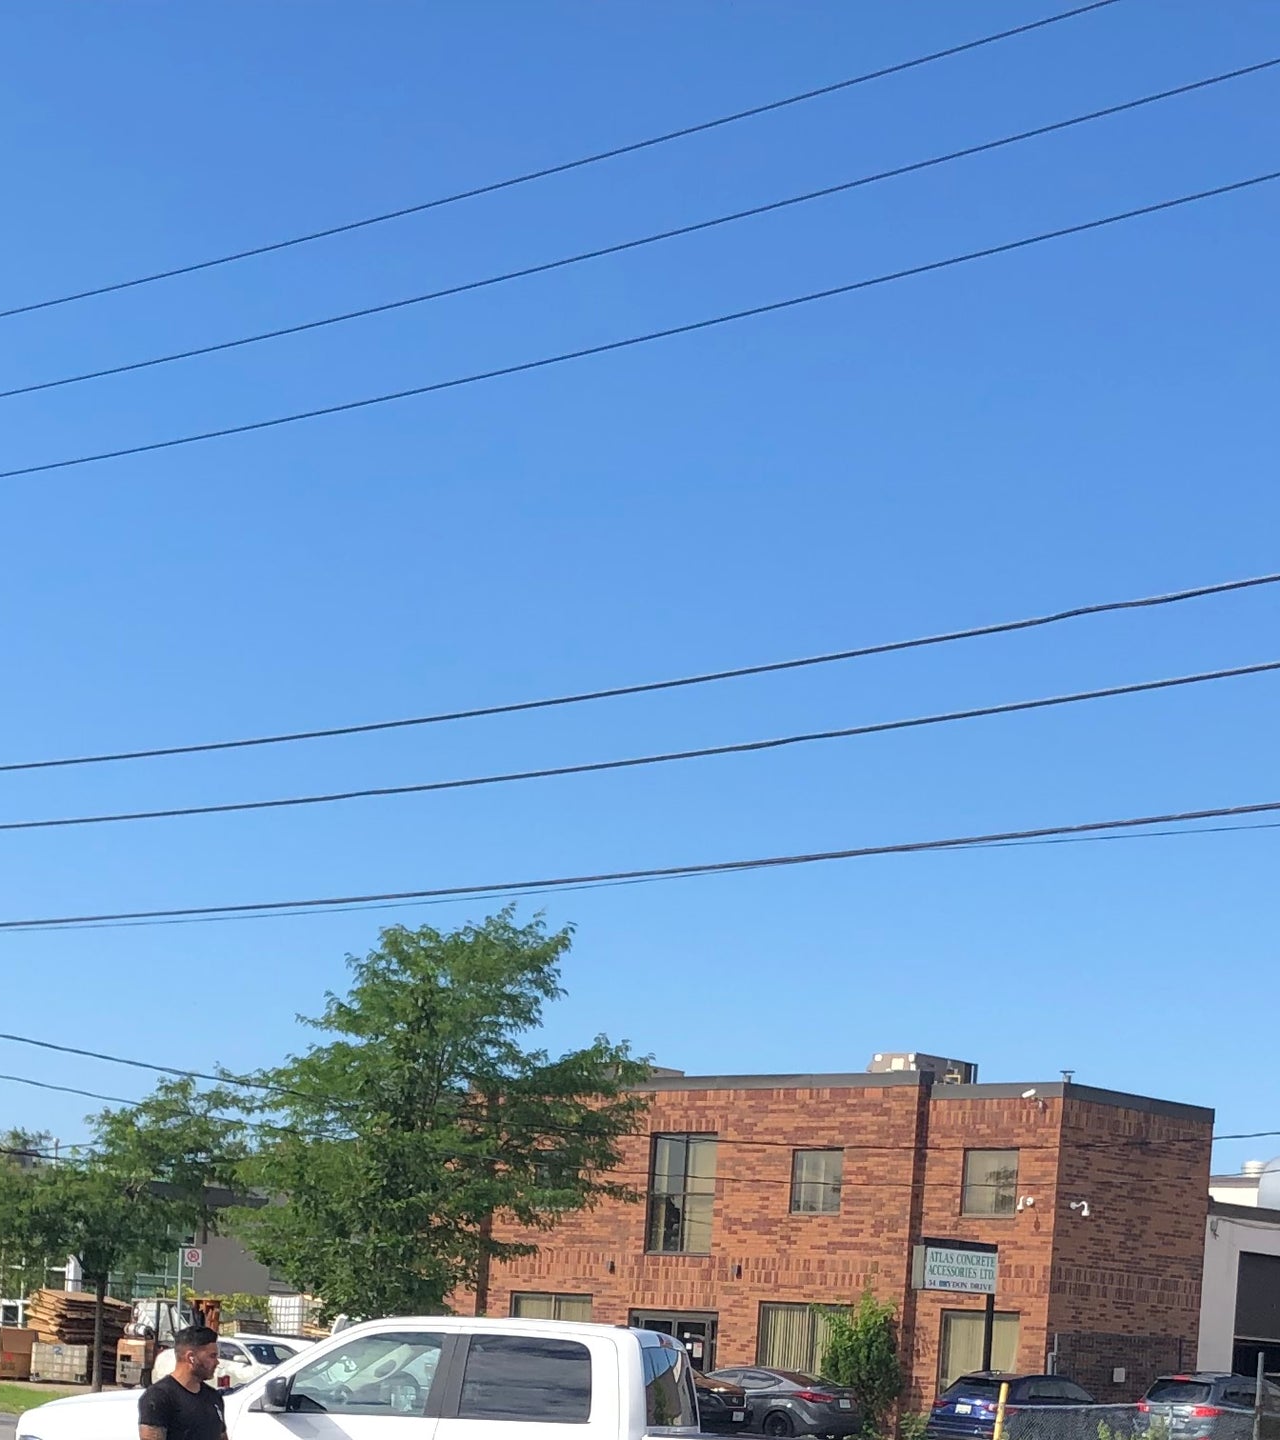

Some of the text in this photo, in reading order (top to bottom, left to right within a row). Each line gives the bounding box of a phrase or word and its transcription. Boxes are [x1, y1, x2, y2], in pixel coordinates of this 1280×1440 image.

[930, 1251, 996, 1267] ATLAS CONCRETE
[928, 1264, 996, 1280] ACCESSORIES LTD.
[970, 1282, 993, 1291] DRIVE
